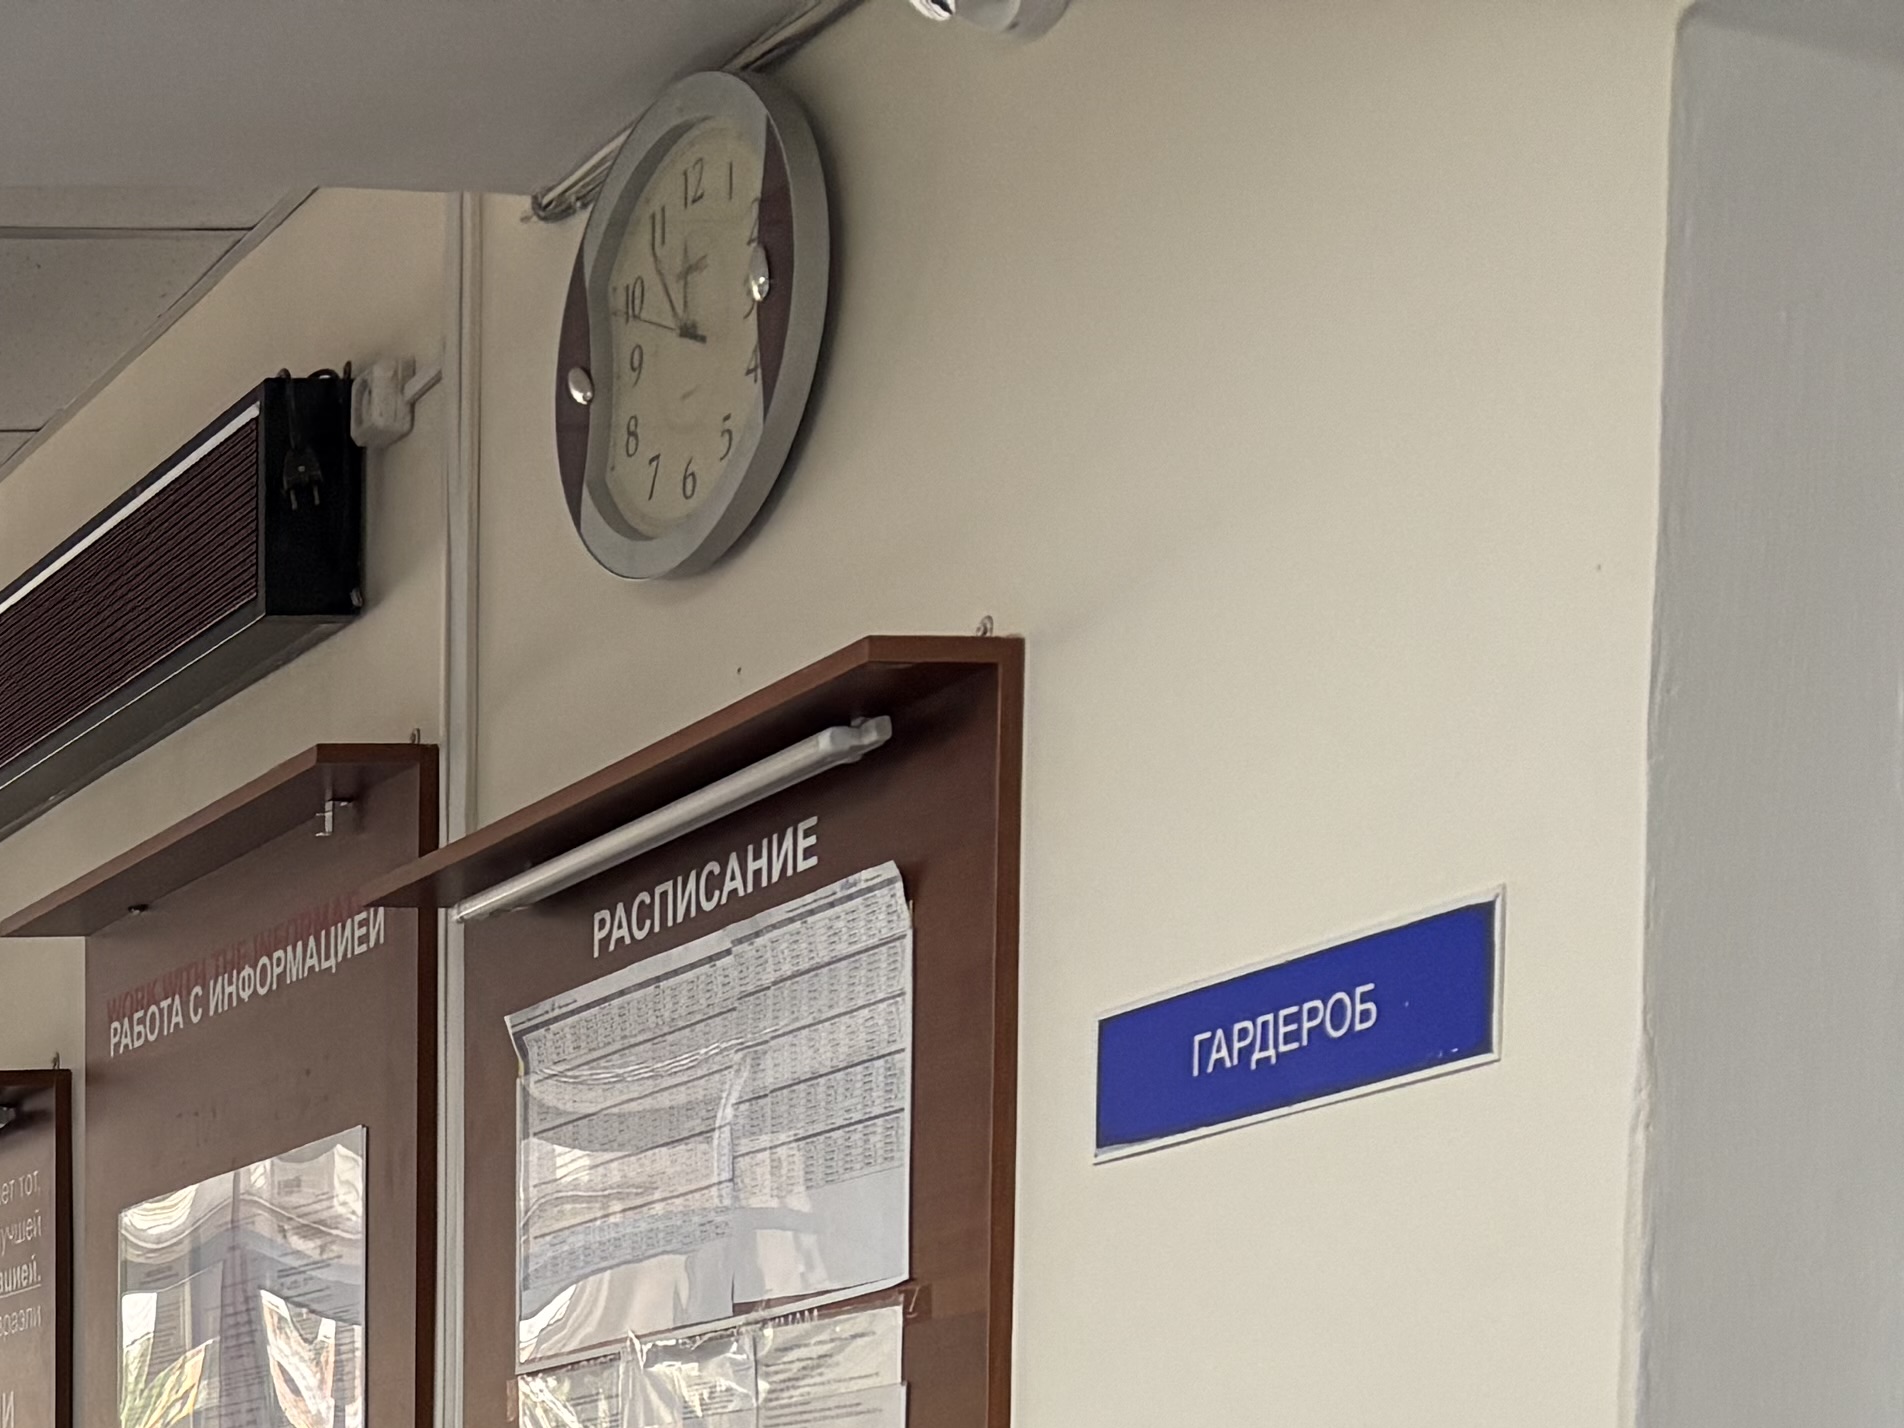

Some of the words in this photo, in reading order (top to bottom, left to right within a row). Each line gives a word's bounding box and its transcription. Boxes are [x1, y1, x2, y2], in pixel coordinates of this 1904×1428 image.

[683, 157, 704, 208] 12
[625, 275, 645, 324] 10
[630, 344, 643, 388] 9
[625, 414, 639, 458] 8
[720, 413, 734, 460] 5
[648, 453, 660, 501] 7
[682, 456, 696, 500] 6
[593, 815, 819, 958] РАСПИСАНИЕ
[110, 994, 183, 1058] РАБОТА
[189, 985, 203, 1024] С
[209, 906, 385, 1017] ИНФОРМАЦИЕЙ
[1192, 983, 1379, 1077] ГАРДЕРОБ
